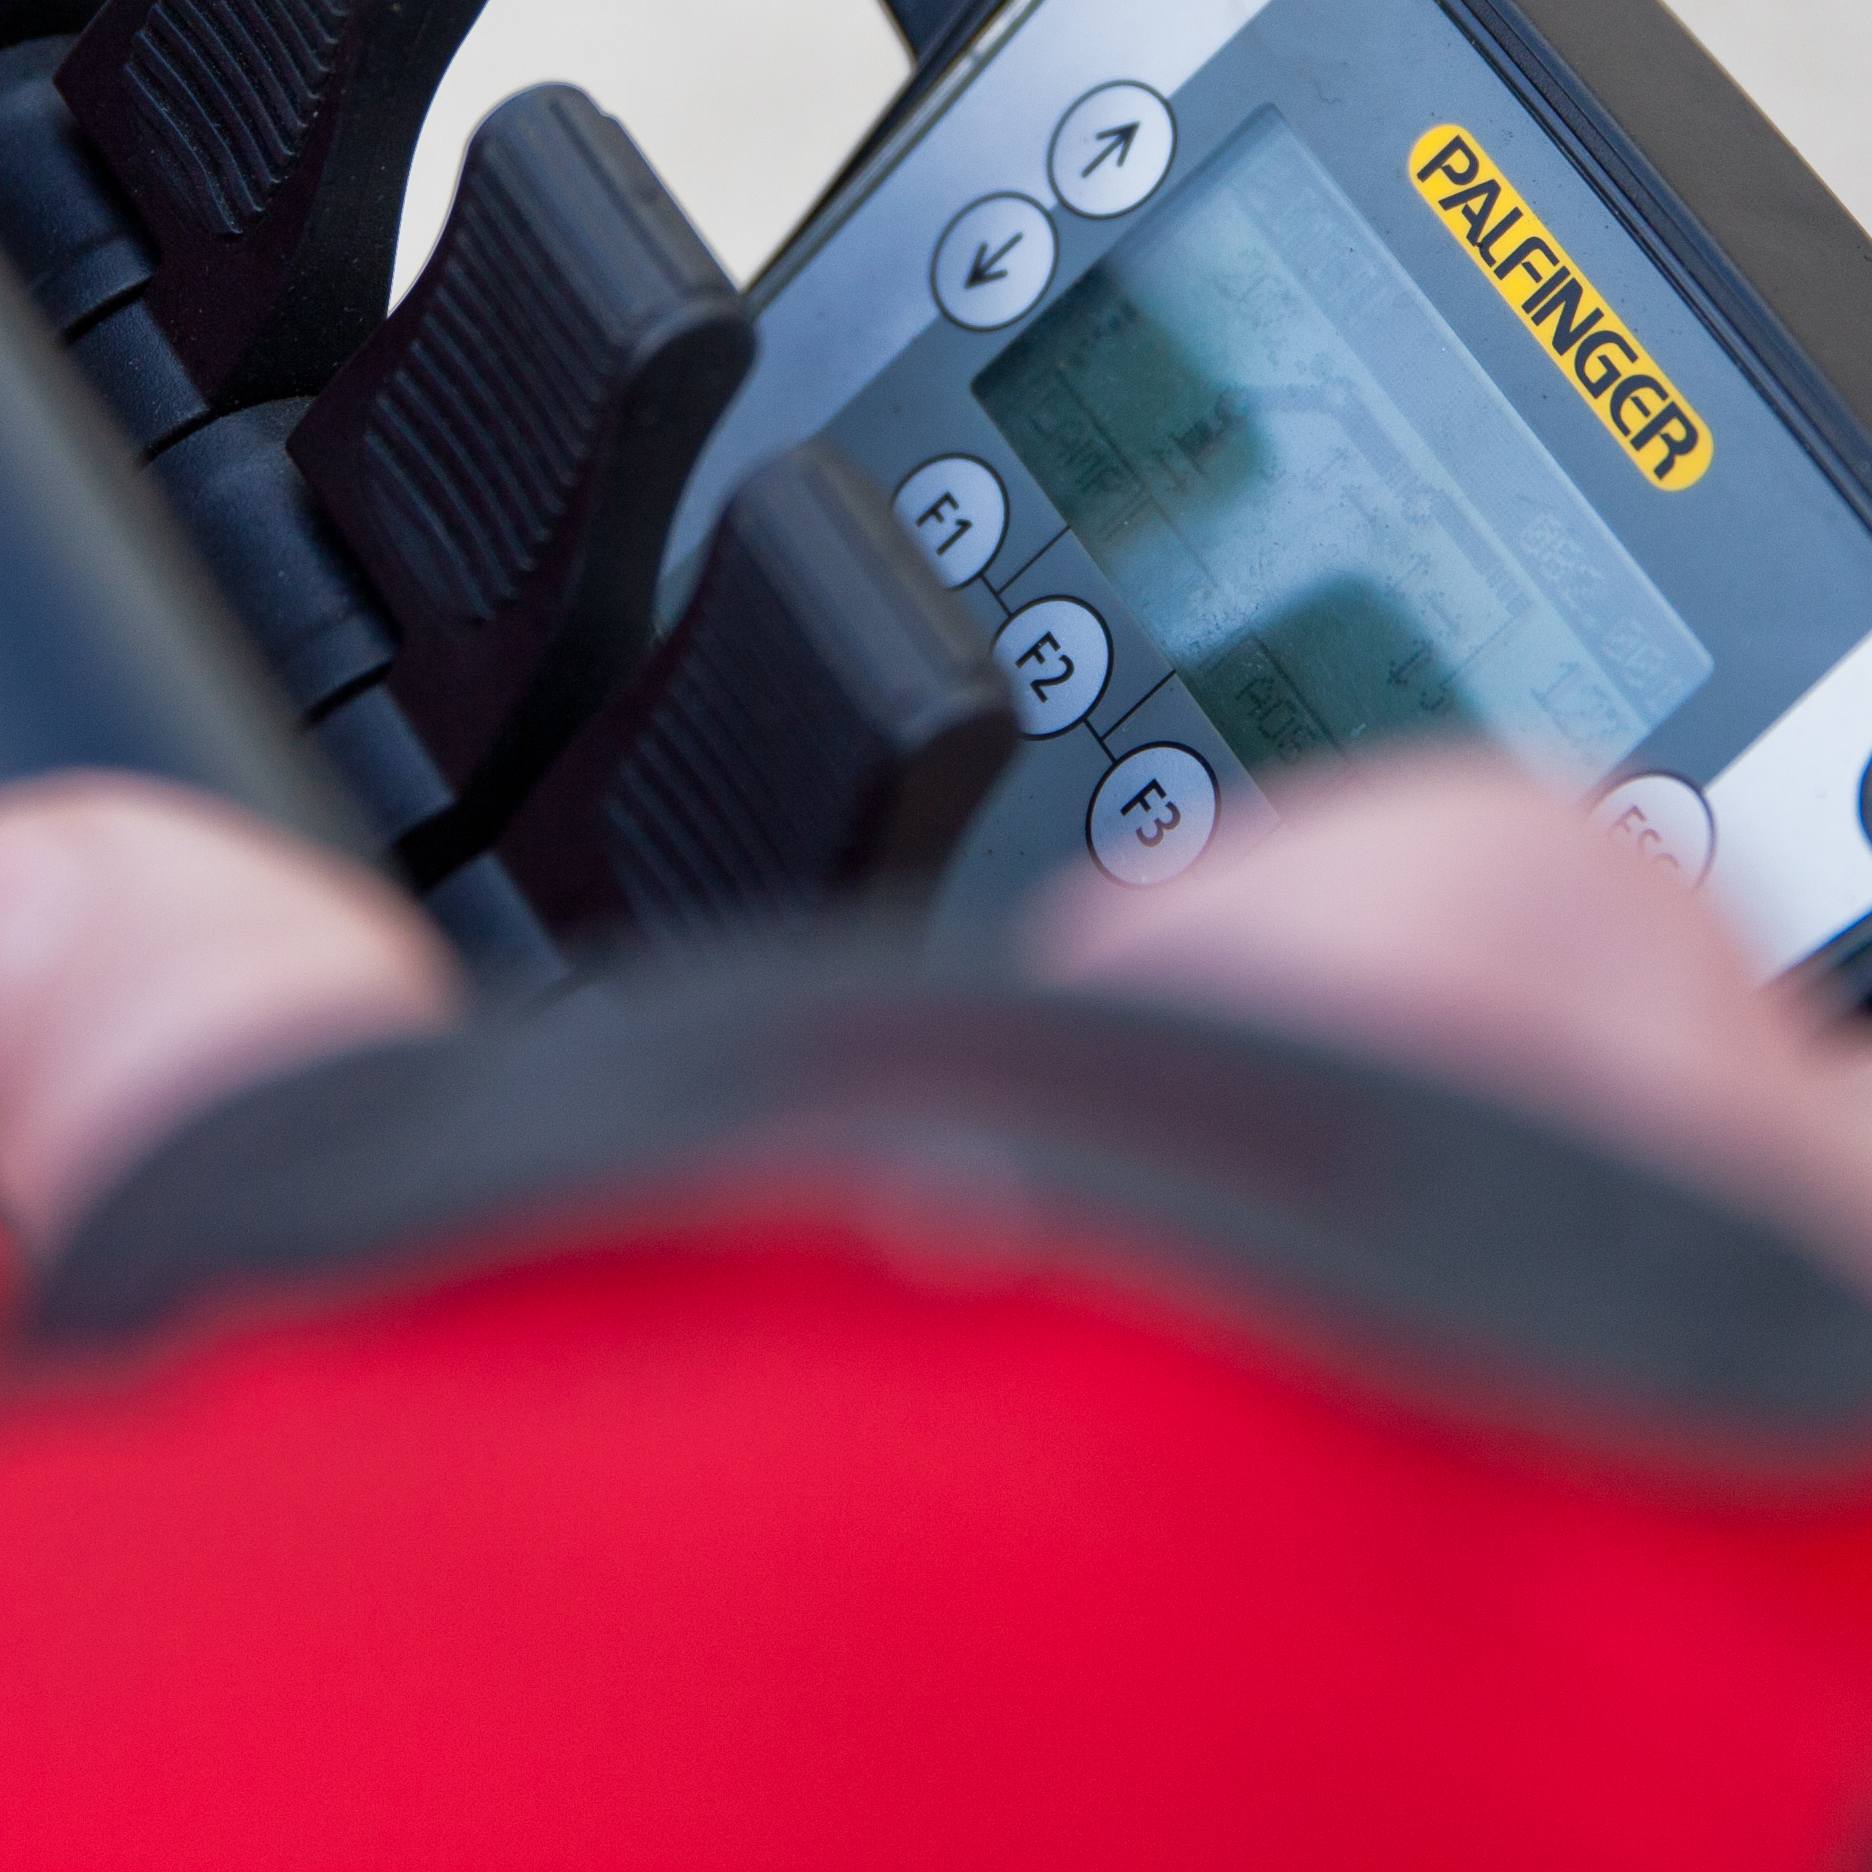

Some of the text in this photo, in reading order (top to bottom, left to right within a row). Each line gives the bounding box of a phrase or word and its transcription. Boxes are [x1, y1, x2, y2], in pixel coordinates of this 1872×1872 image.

[1416, 135, 1698, 480] PALFINGER
[915, 491, 973, 556] F1
[1015, 631, 1075, 703] F2
[1120, 778, 1181, 848] F3
